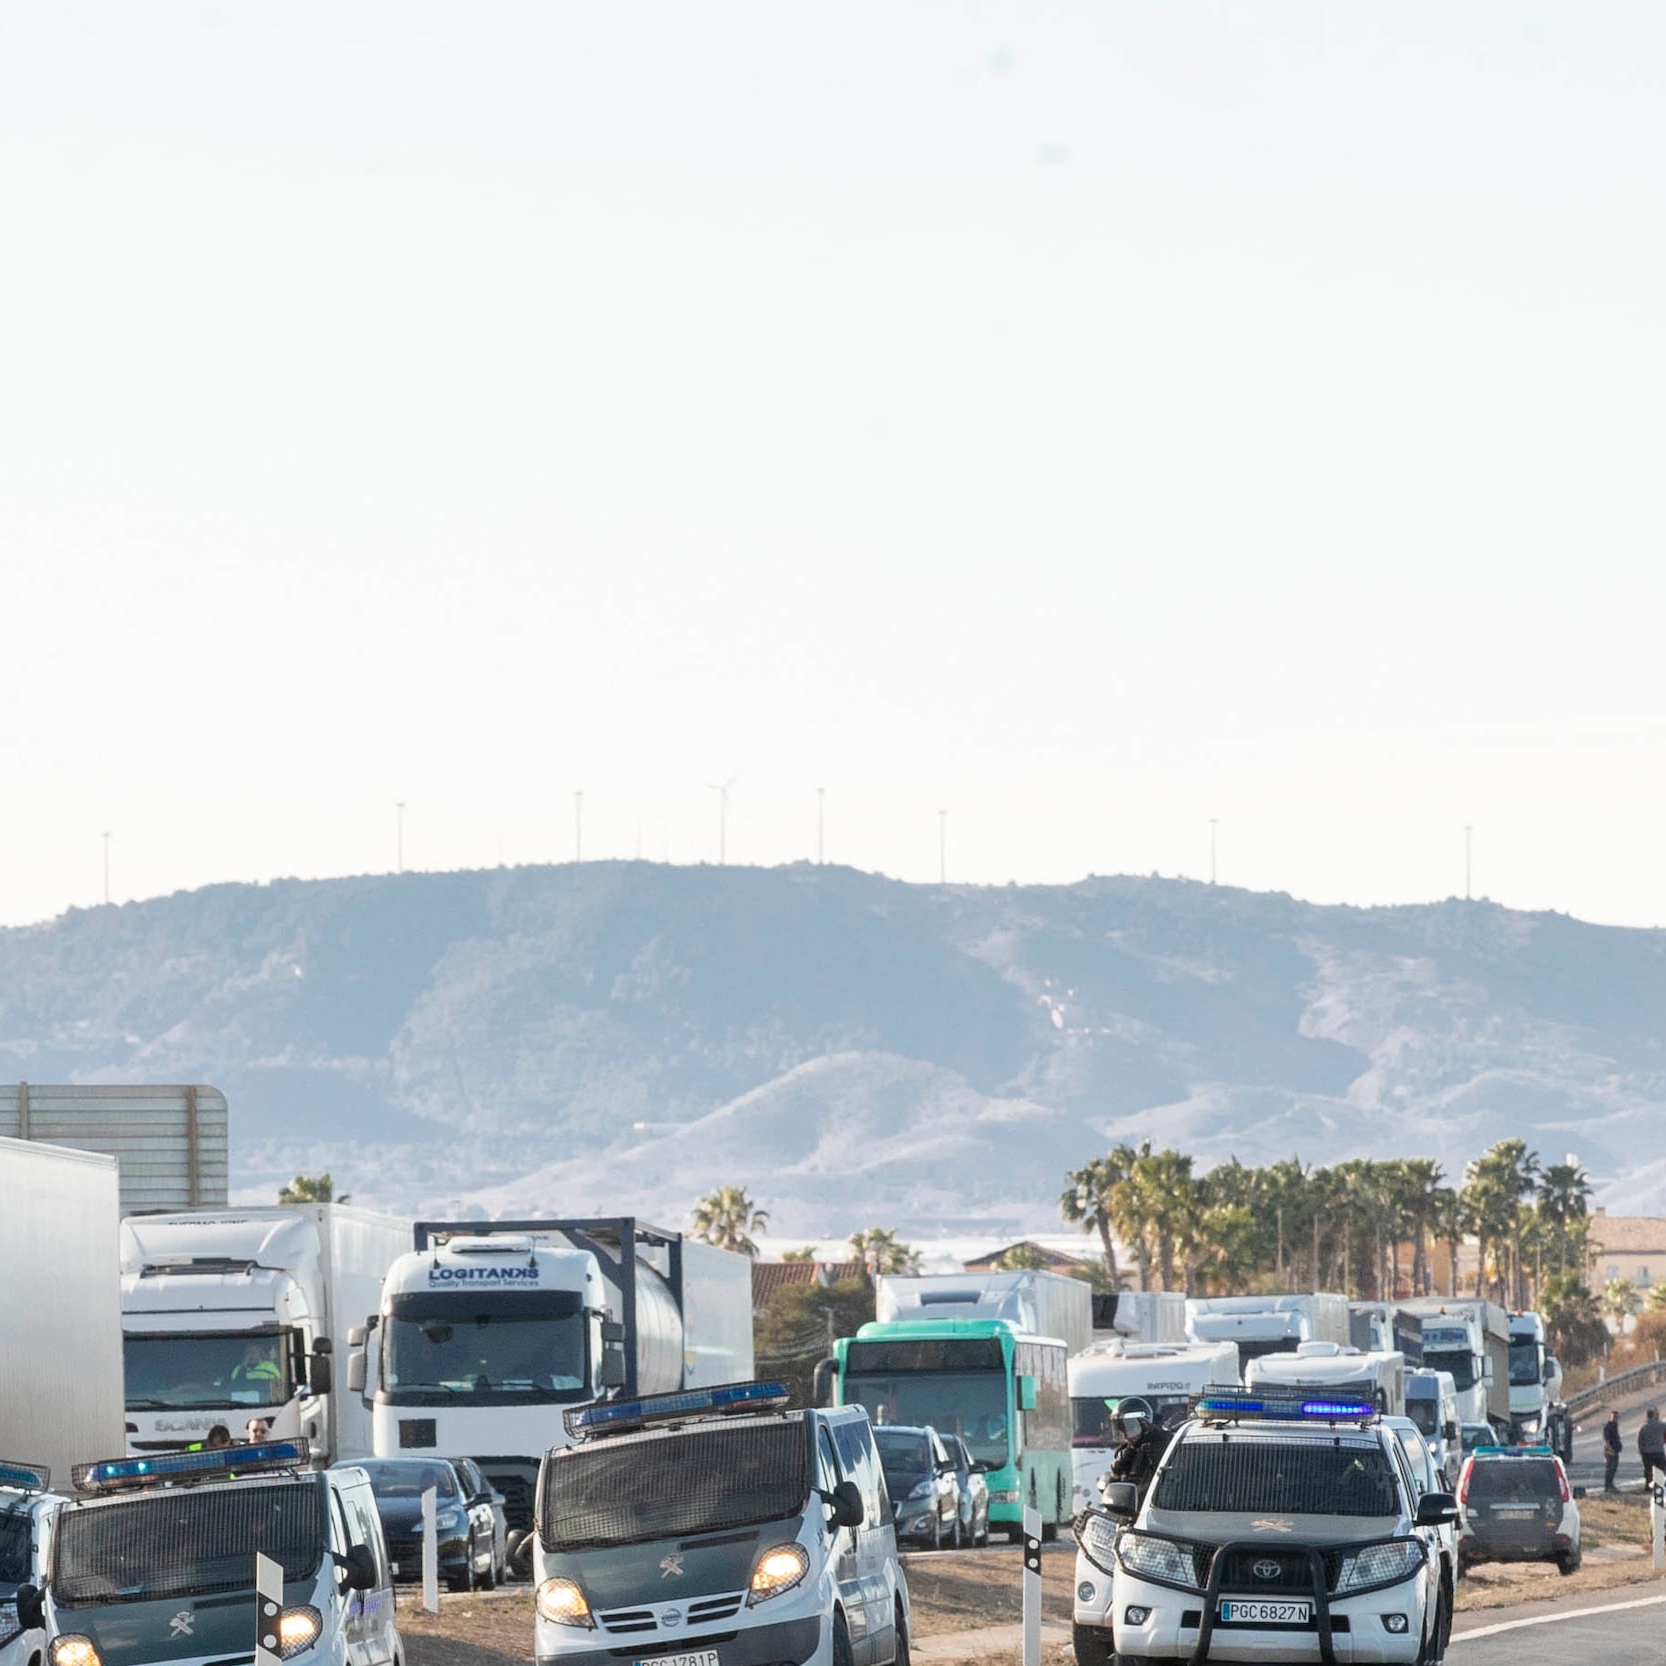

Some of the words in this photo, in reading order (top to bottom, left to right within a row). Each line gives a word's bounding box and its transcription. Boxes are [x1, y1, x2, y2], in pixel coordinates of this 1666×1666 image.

[429, 1267, 539, 1281] LOGITANKS
[462, 1278, 501, 1287] Transport
[503, 1279, 539, 1287] Services
